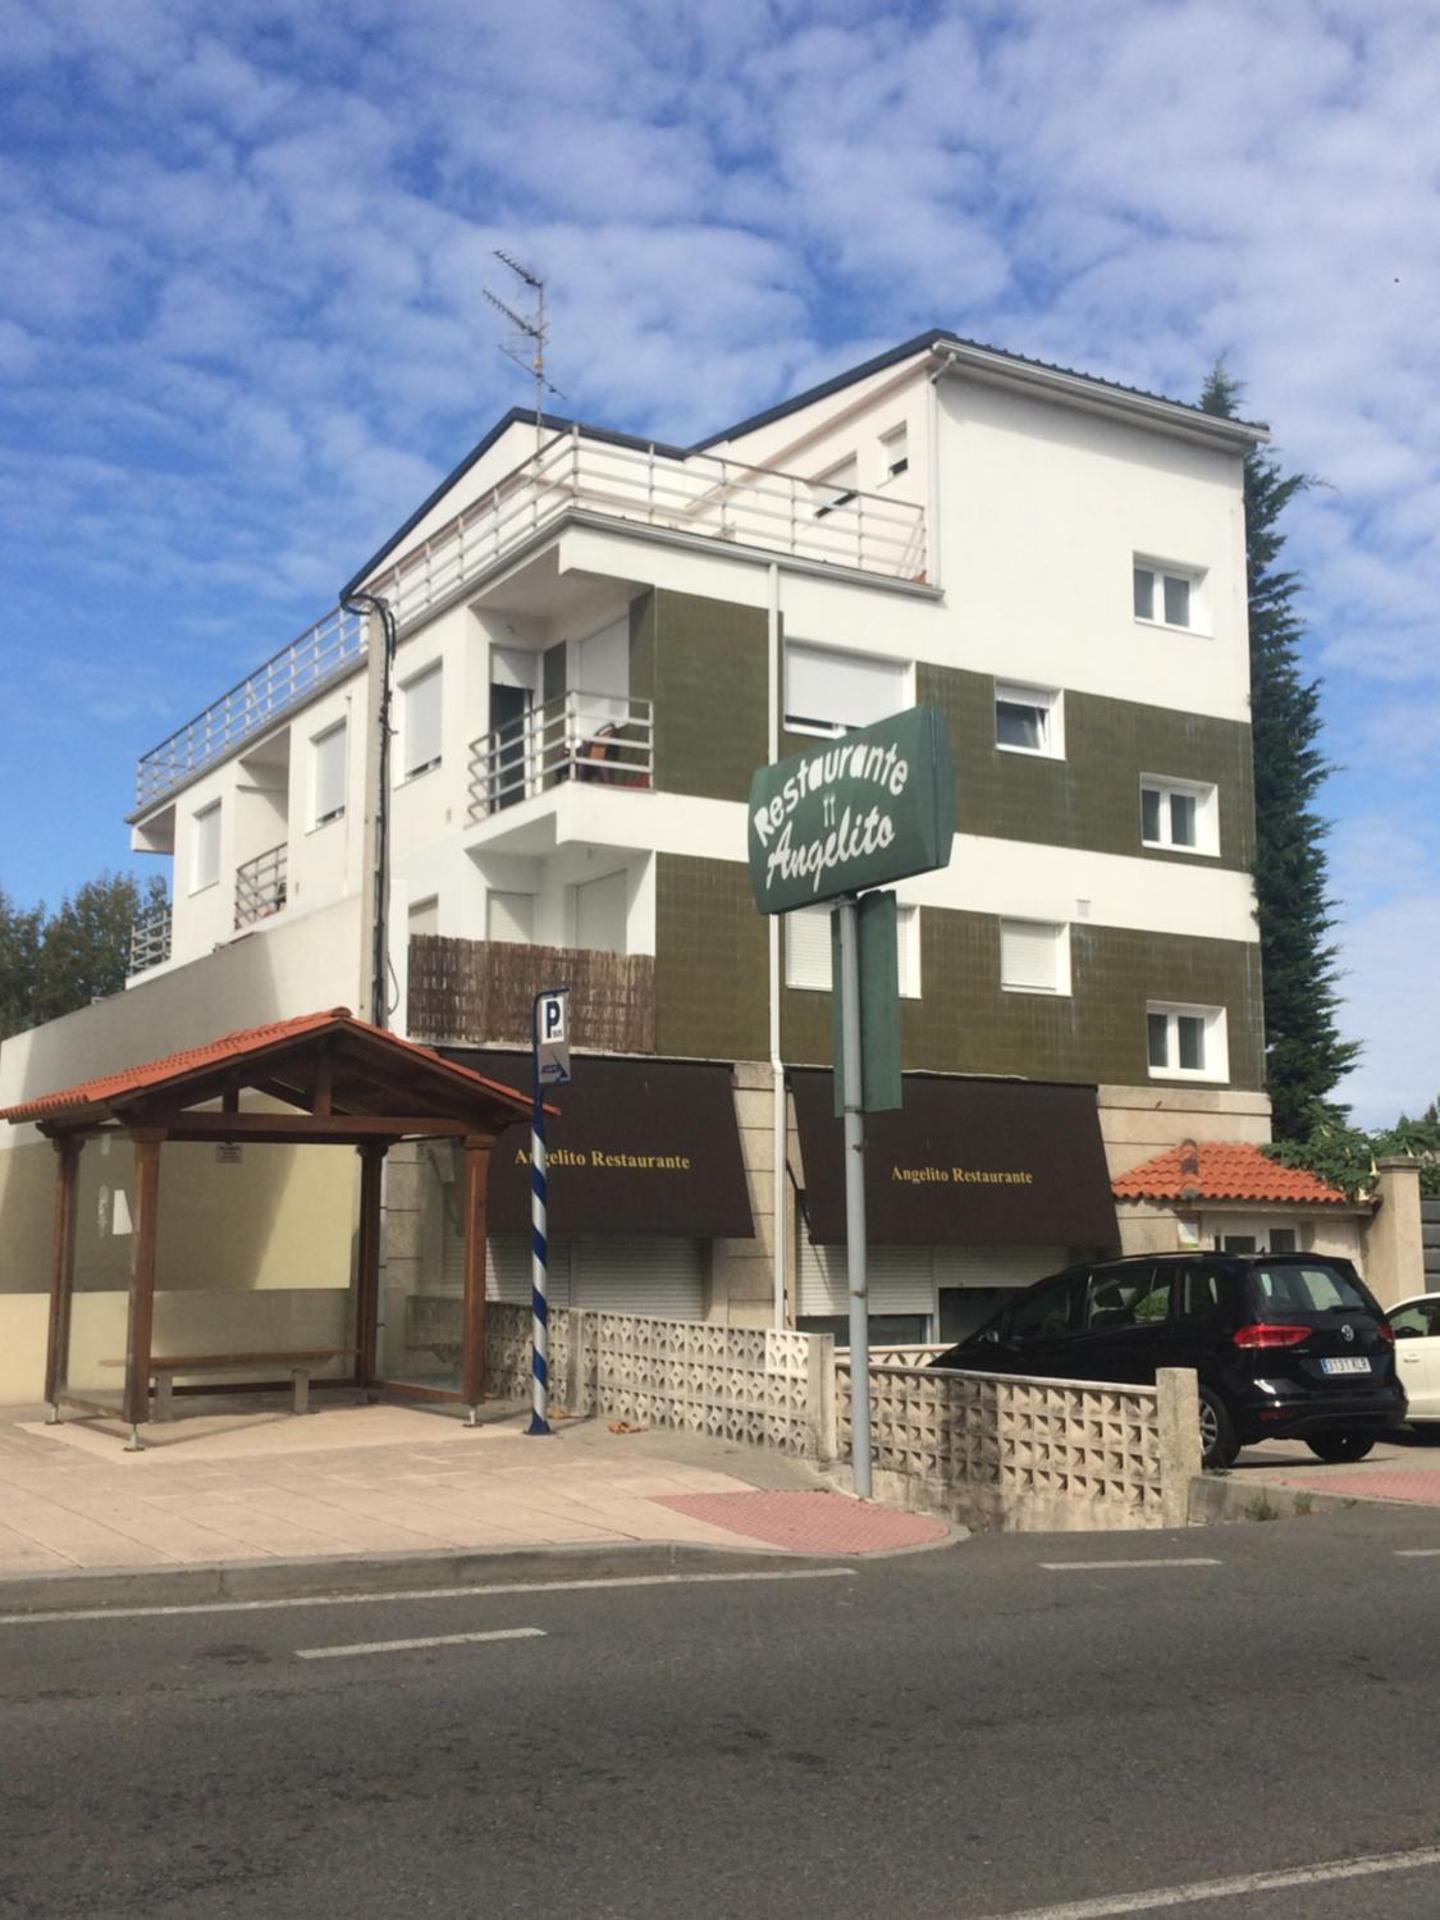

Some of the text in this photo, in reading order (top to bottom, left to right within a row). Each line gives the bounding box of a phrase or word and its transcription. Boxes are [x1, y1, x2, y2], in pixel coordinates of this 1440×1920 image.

[754, 743, 908, 847] Restaurante
[766, 805, 895, 893] Angelito
[546, 1000, 561, 1038] P
[514, 1149, 691, 1169] Aelito Restaurante
[891, 1166, 1033, 1185] Angelito Restaurante
